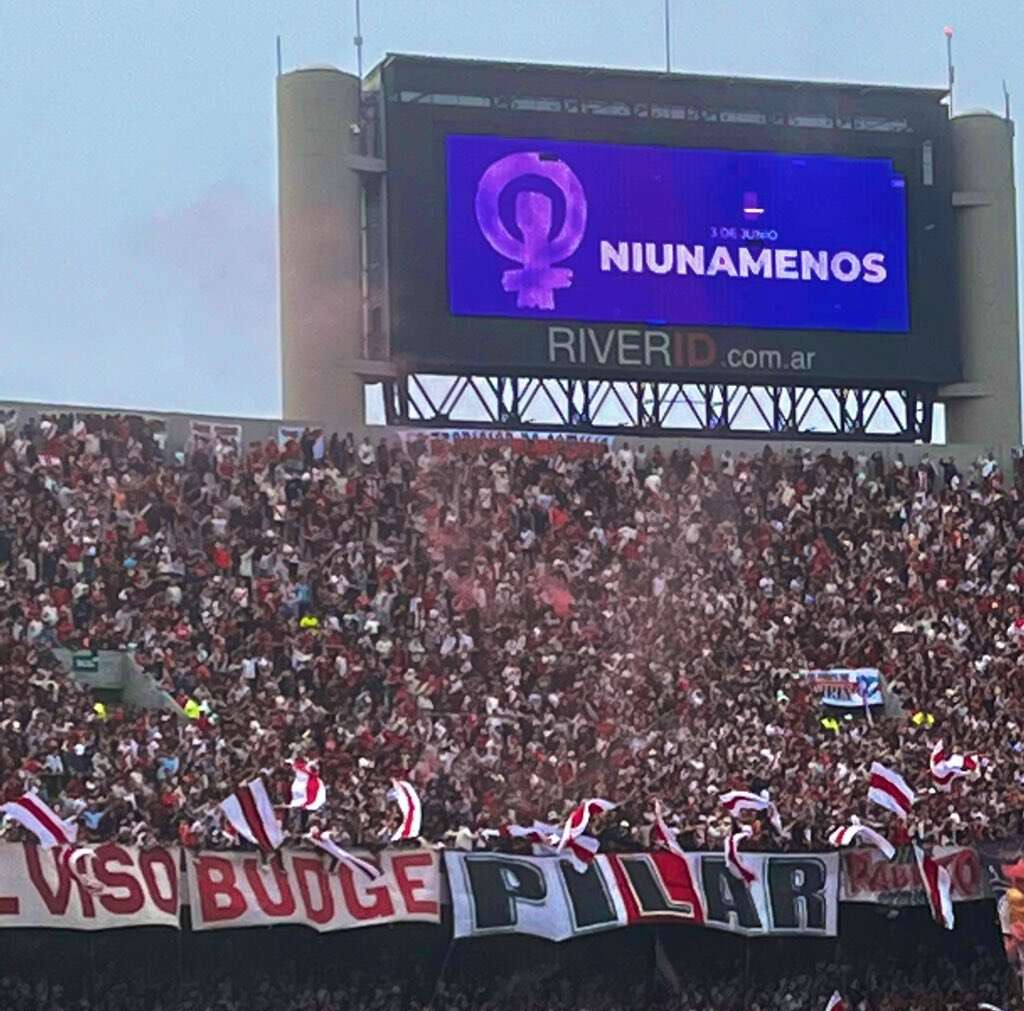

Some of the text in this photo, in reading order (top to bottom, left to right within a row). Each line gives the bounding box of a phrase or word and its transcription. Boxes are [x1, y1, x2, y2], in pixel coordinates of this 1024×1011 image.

[600, 240, 888, 283] NIUNAMENOS
[198, 852, 438, 923] BUDGE
[466, 852, 828, 936] PILAR
